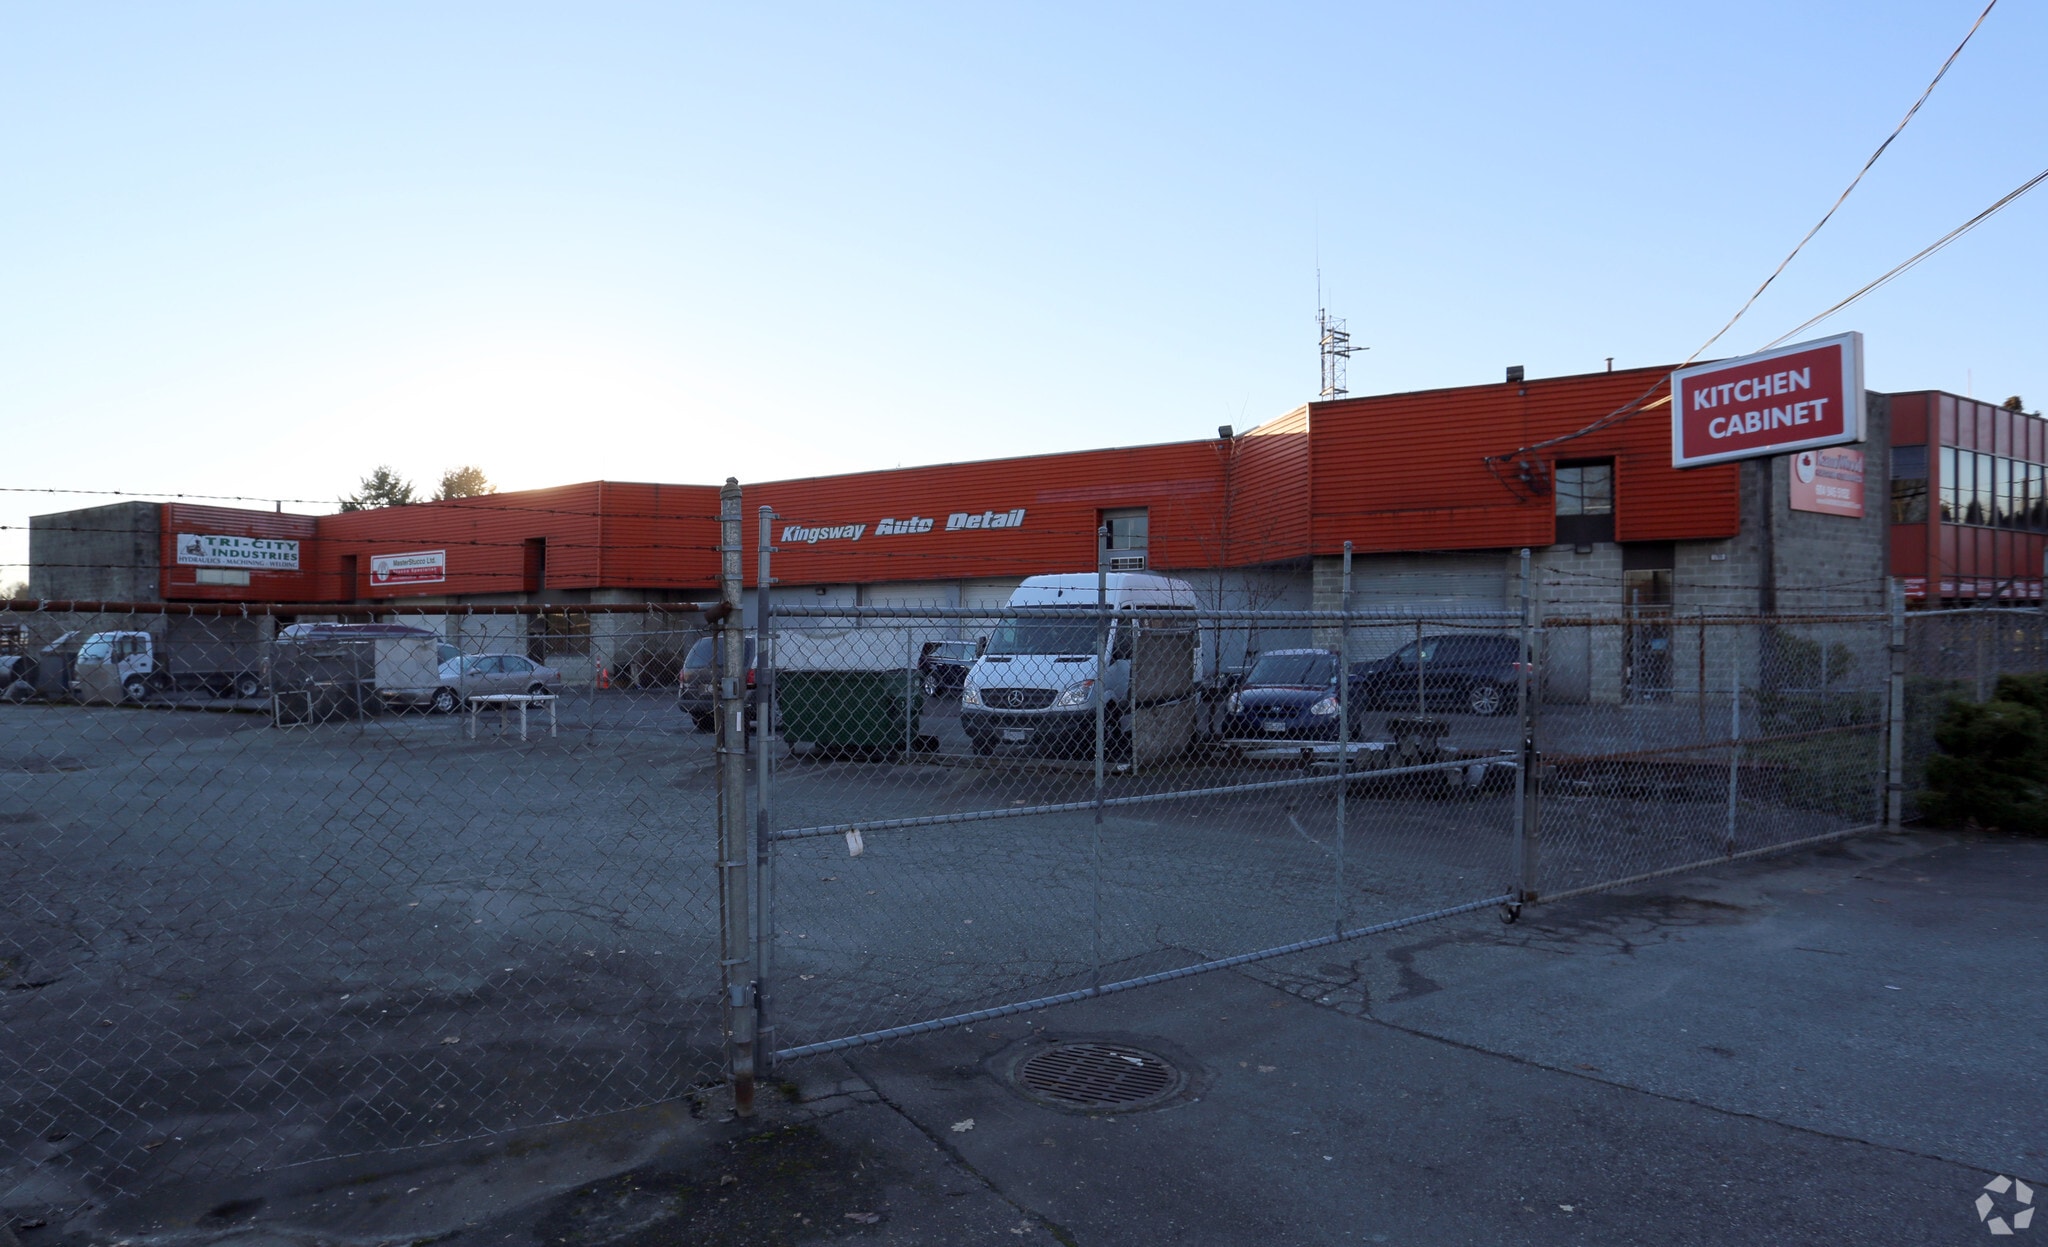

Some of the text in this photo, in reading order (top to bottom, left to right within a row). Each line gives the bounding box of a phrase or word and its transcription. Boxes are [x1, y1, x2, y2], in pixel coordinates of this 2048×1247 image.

[1694, 367, 1810, 411] KITCHEN
[1708, 397, 1829, 439] CABINET
[781, 508, 1027, 544] Kingsway Auto Detail
[206, 537, 298, 551] TRI-CITY
[212, 548, 298, 561] INDUSTRIES
[226, 559, 265, 567] MACHINING
